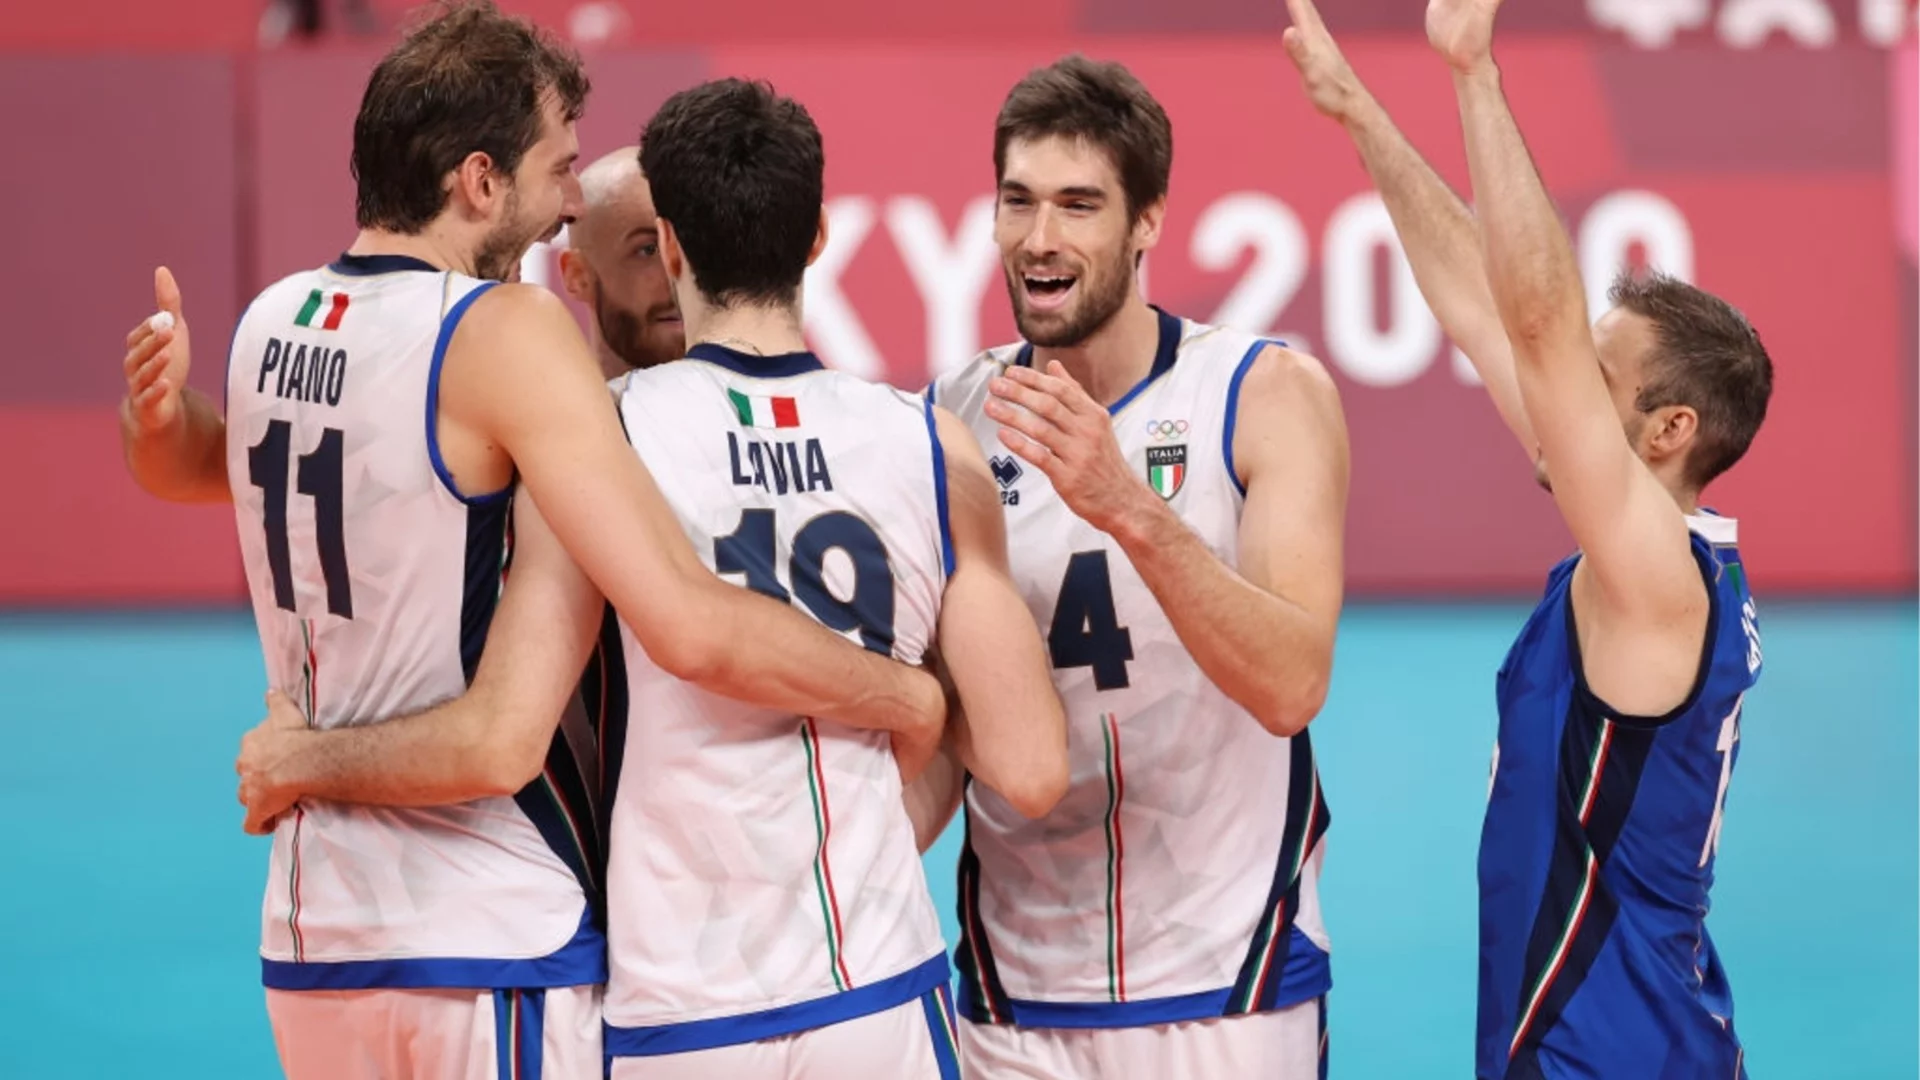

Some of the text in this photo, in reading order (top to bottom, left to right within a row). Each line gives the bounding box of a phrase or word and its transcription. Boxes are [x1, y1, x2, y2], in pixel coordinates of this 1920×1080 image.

[258, 337, 347, 406] PIANO
[727, 431, 833, 495] LAVIA
[1149, 447, 1184, 459] ITALIA
[248, 418, 353, 620] 11
[713, 508, 895, 657] 19
[1047, 549, 1134, 692] 4
